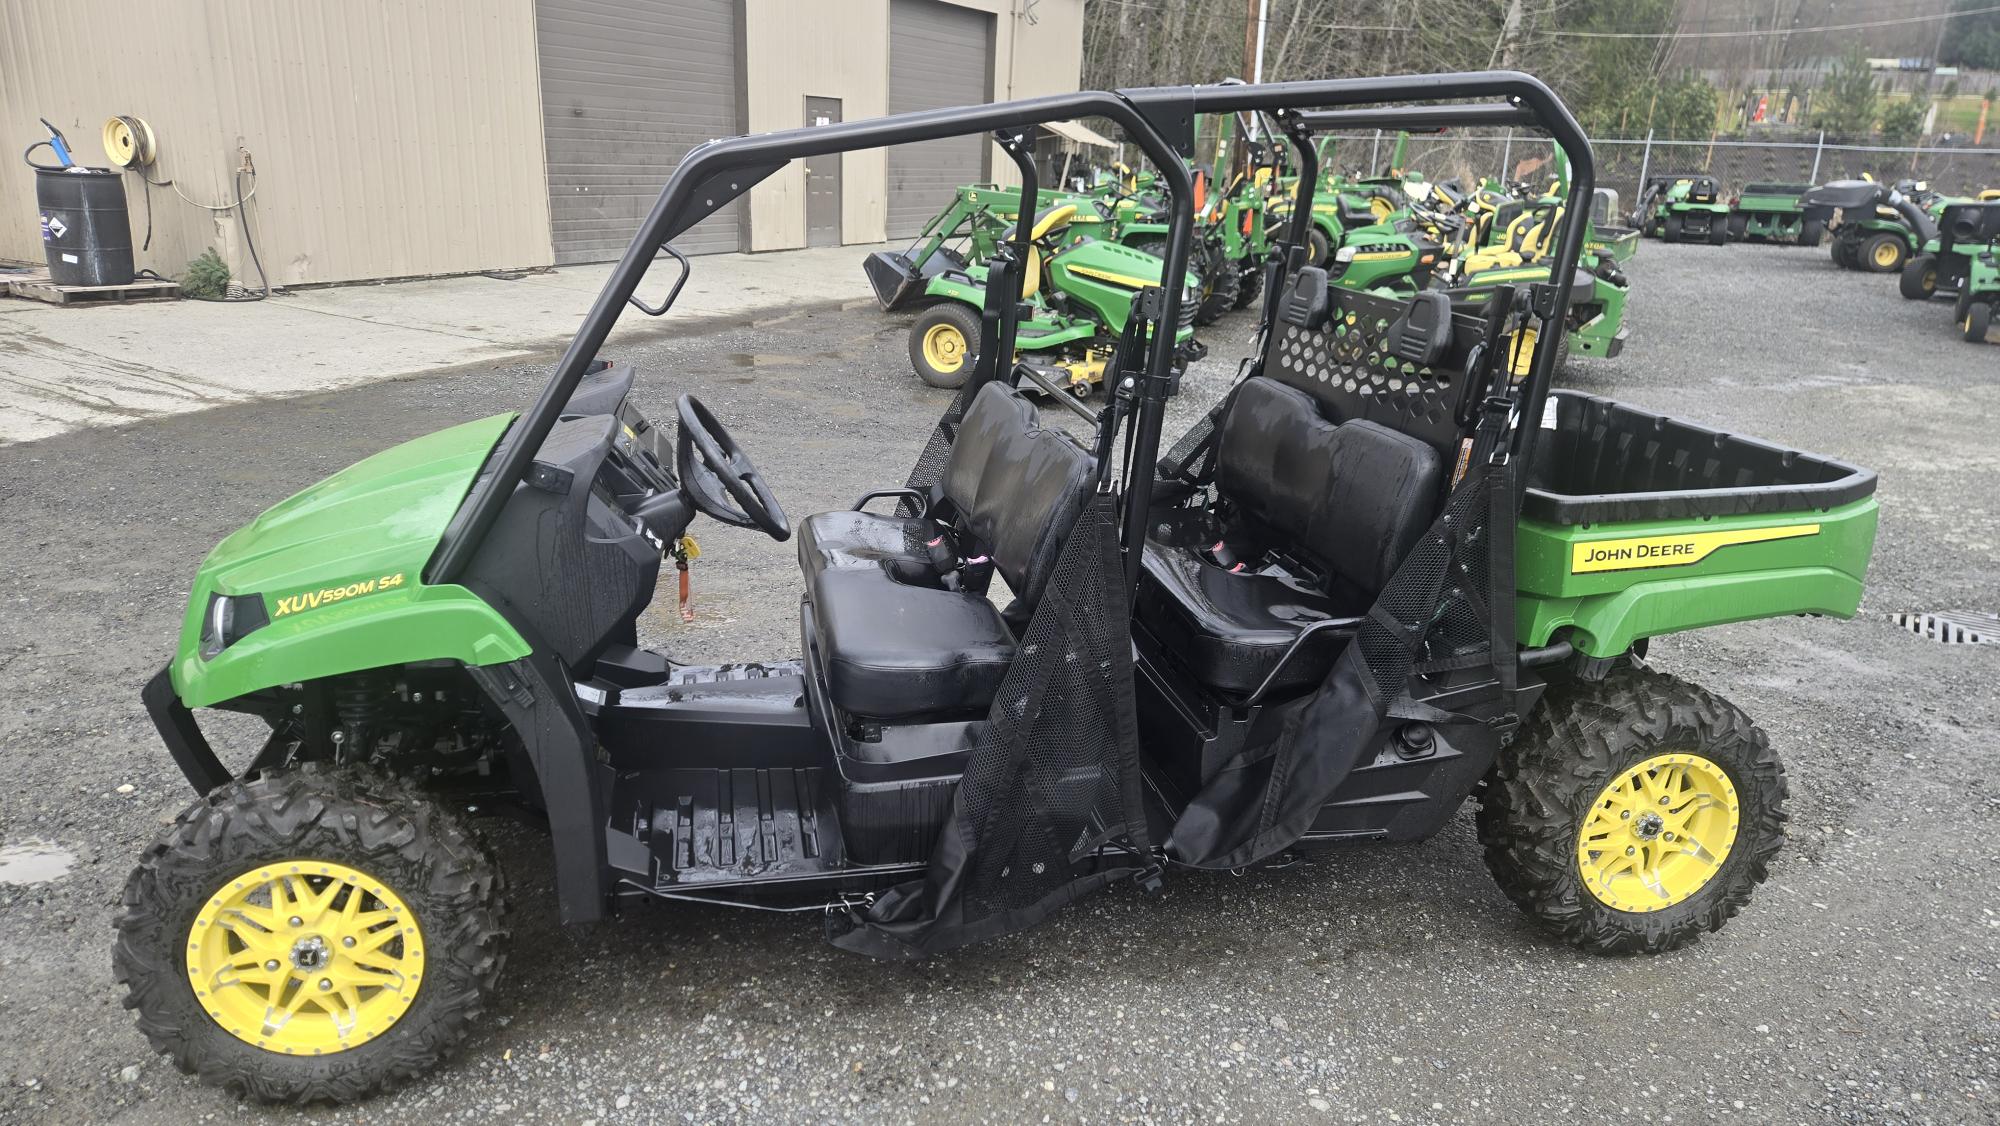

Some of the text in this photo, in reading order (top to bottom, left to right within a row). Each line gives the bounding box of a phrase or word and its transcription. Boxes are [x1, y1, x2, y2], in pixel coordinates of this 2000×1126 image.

[1584, 543, 1695, 563] JOHN DEERE
[274, 572, 404, 617] XUV590M S4
